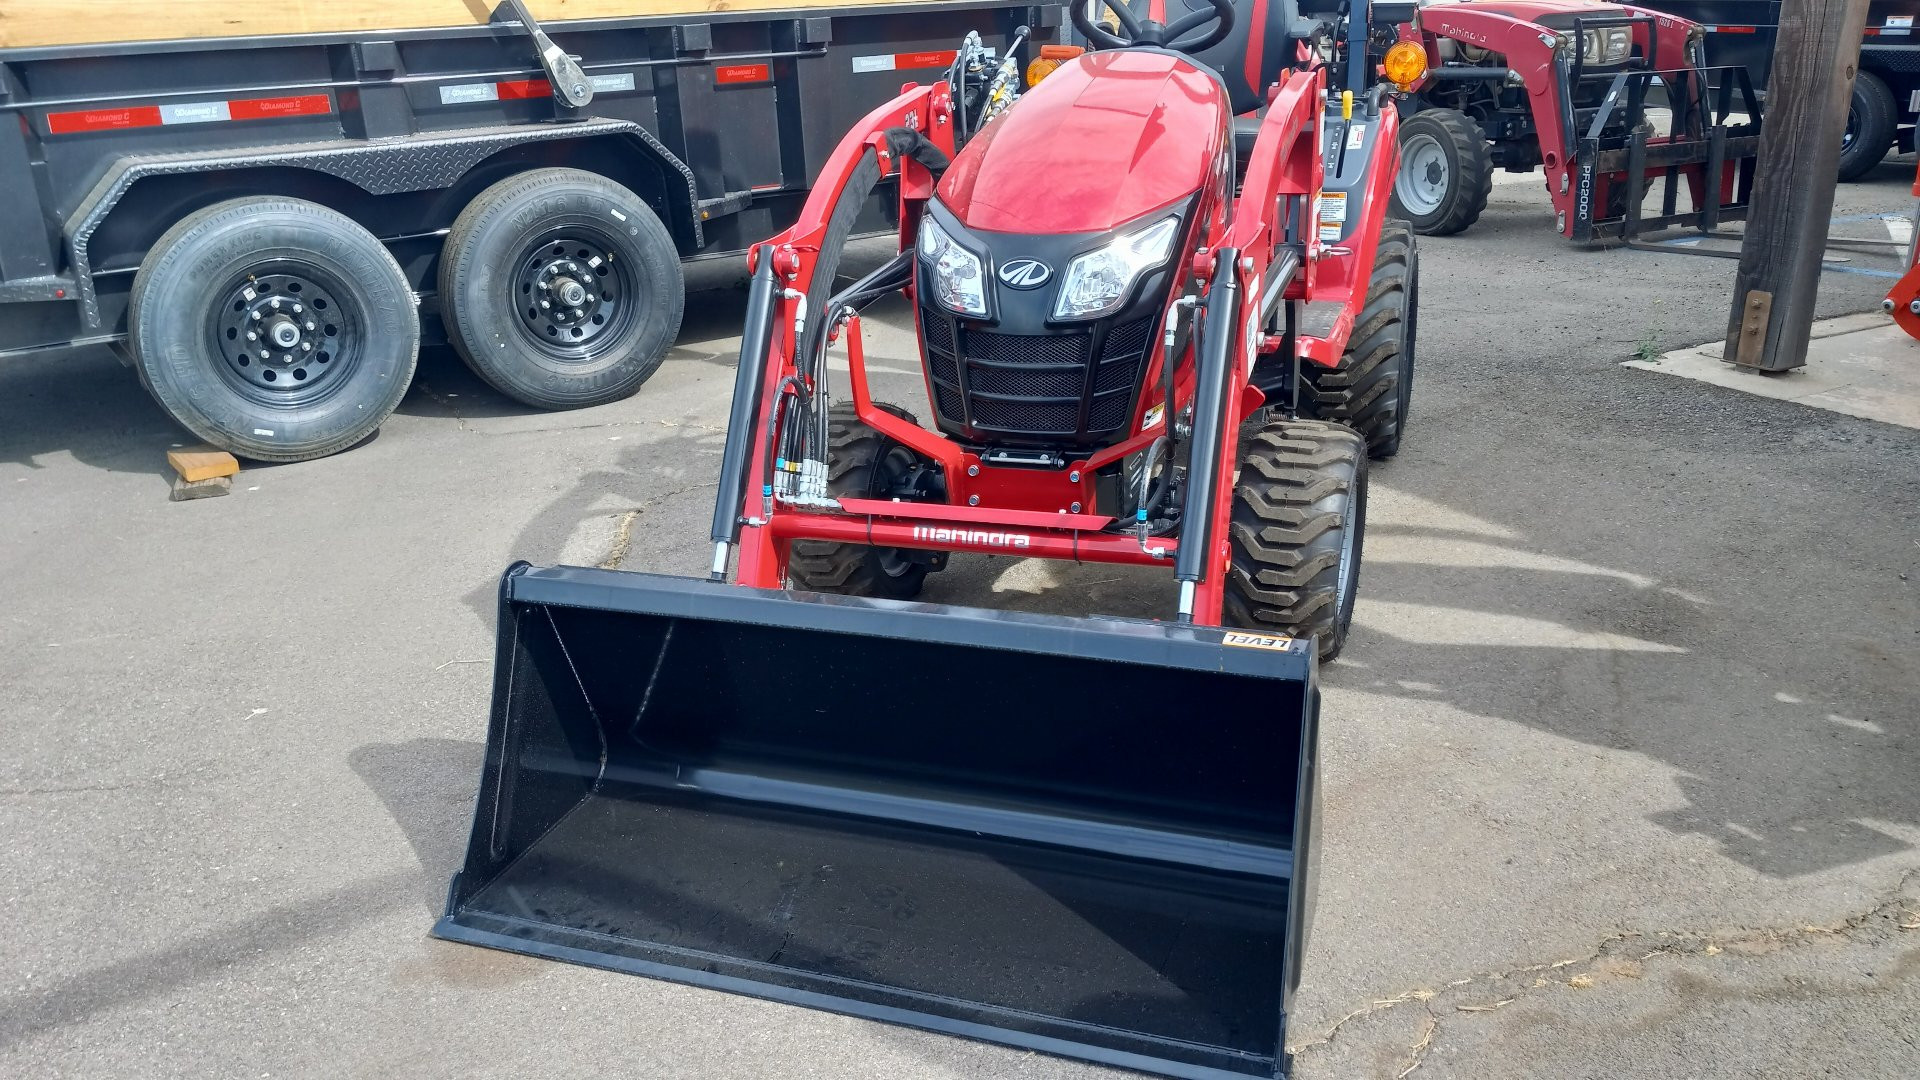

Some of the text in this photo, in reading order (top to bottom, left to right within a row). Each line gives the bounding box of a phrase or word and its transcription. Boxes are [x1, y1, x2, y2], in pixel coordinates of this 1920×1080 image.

[264, 102, 294, 110] DIAMOND
[89, 114, 123, 122] DIAMOND
[1579, 165, 1592, 220] PFC2000
[1227, 634, 1288, 648] LEVEL
